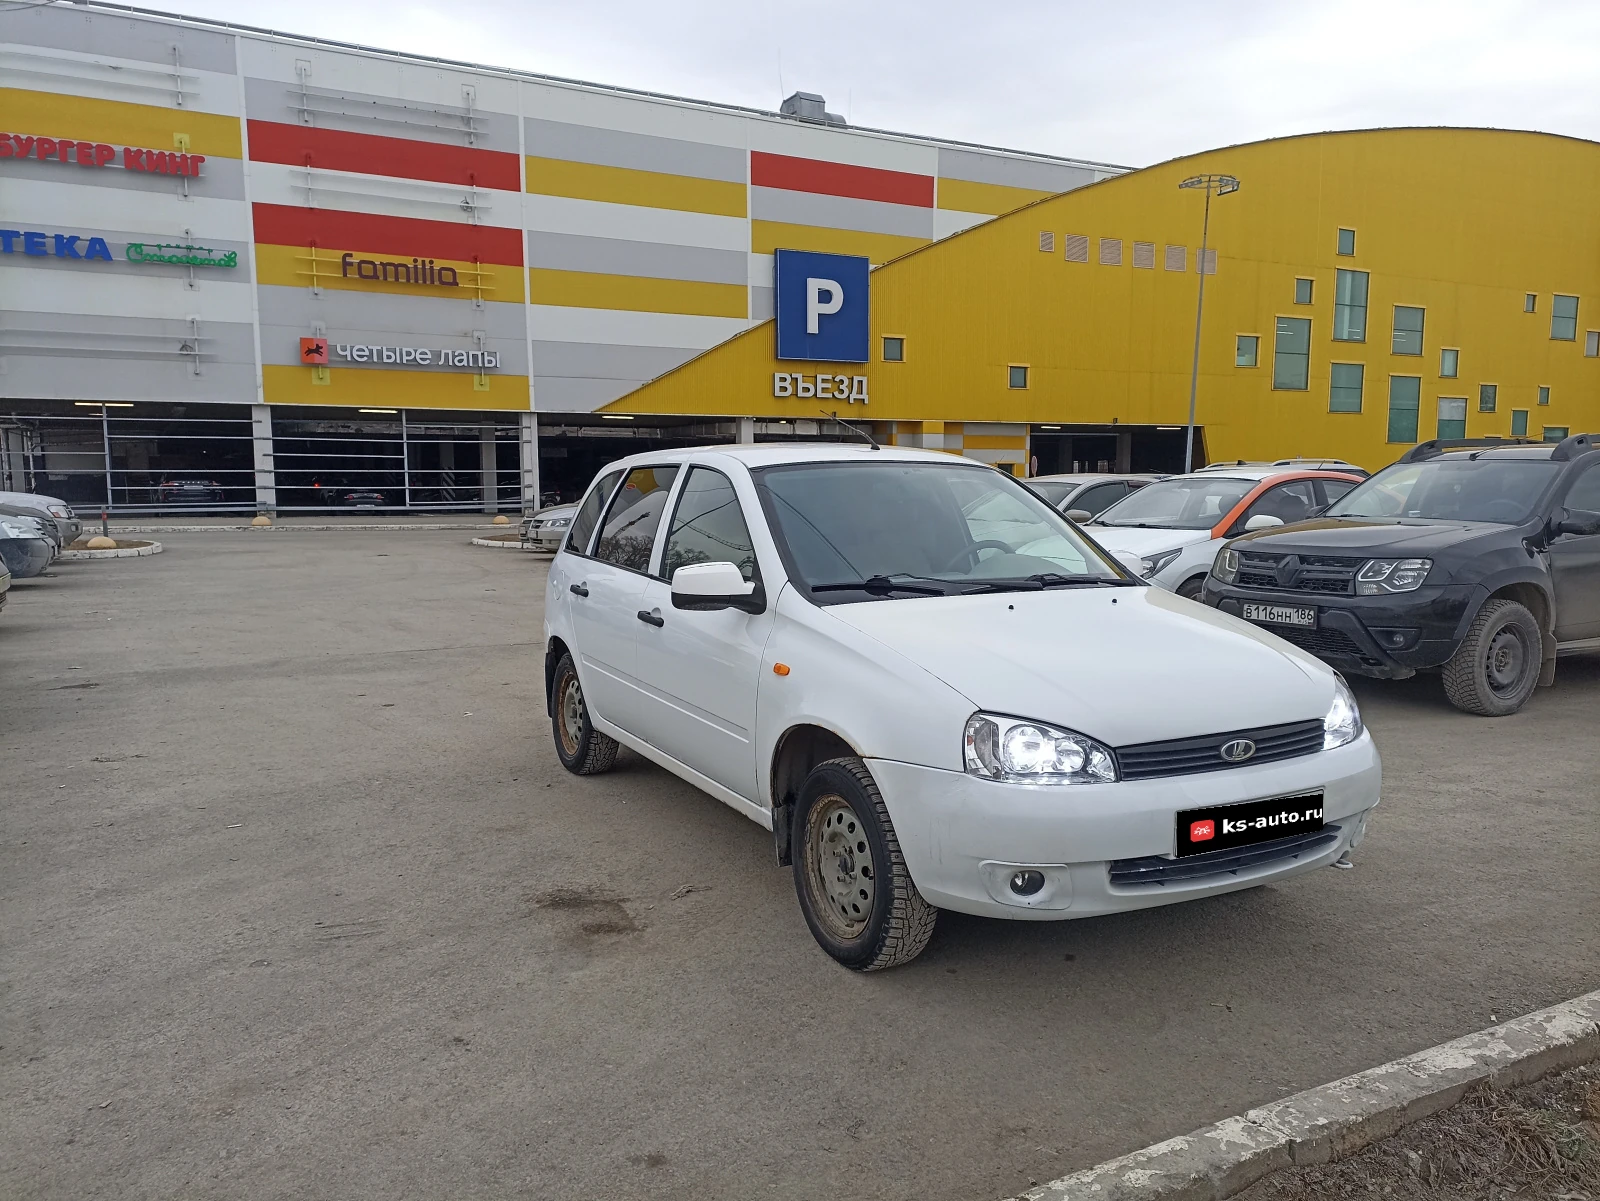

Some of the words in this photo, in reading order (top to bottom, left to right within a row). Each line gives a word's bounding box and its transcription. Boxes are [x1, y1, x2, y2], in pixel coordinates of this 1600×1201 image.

[123, 147, 206, 177] КИНГ
[341, 252, 459, 286] familia
[806, 277, 844, 334] P
[336, 344, 432, 365] четыре
[438, 349, 501, 368] лапы
[773, 372, 869, 404] ВЪЕЗД
[1294, 608, 1313, 620] 186
